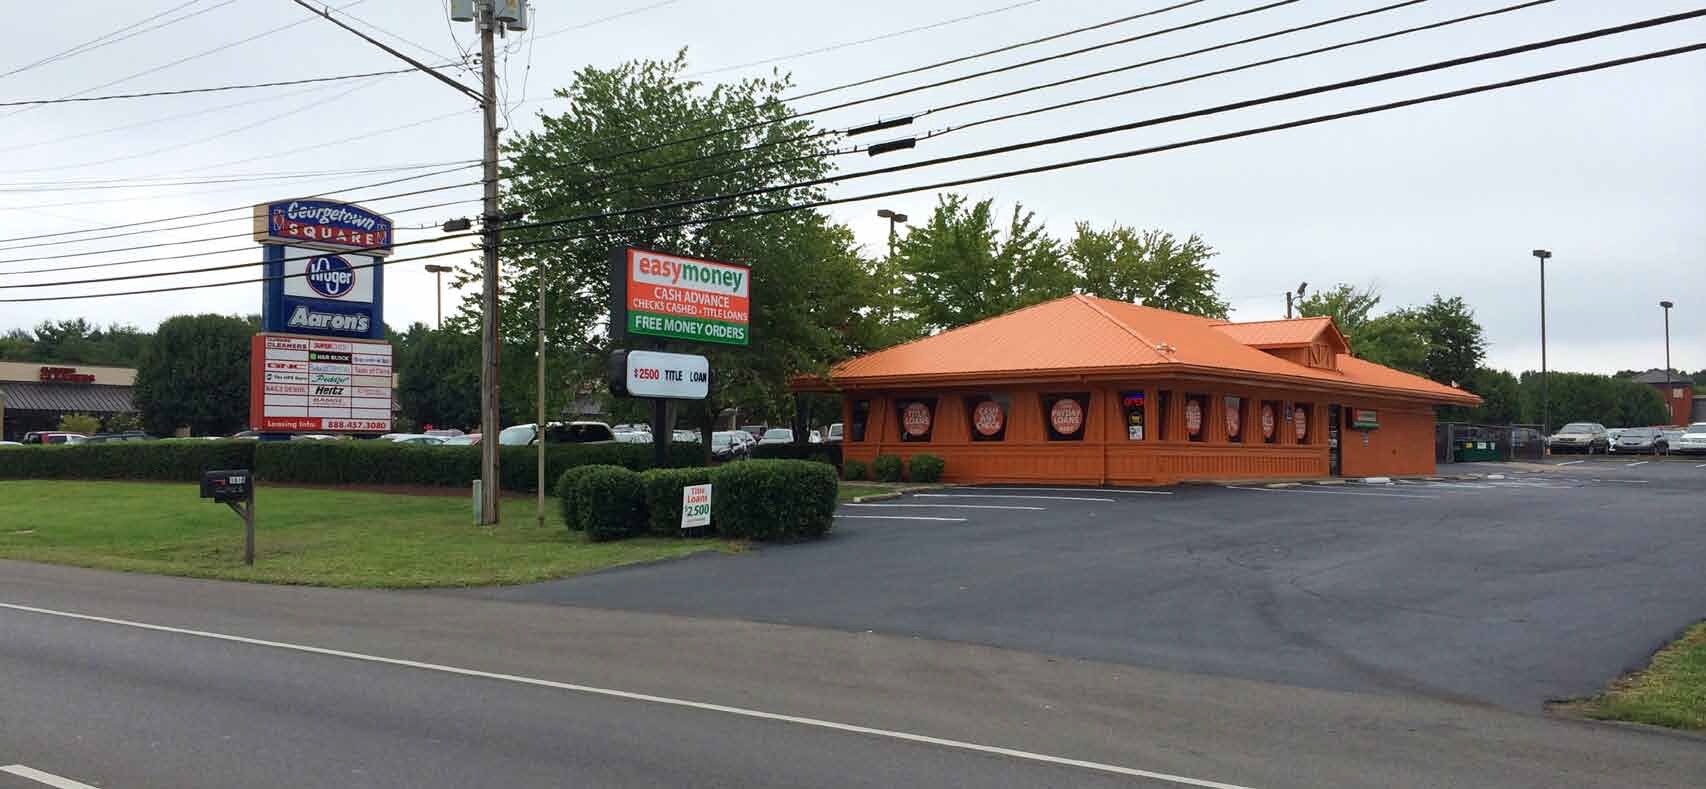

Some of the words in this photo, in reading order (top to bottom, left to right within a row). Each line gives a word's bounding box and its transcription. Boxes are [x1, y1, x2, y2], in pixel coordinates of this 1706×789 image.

[288, 202, 375, 230] Georgetown
[288, 223, 375, 245] SQUARE
[311, 257, 352, 294] Kroger
[654, 287, 682, 302] CASH
[683, 291, 729, 308] ADVANCE
[288, 305, 369, 332] Aaron's
[633, 298, 665, 312] CHECKS
[666, 302, 698, 315] CASHED
[703, 307, 722, 319] TITLE
[723, 310, 748, 321] LOANS
[635, 315, 662, 331] FREE
[664, 318, 704, 335] MONEY
[705, 325, 745, 339] ORDERS
[633, 367, 660, 380] $2500
[665, 369, 683, 381] TITLE
[689, 371, 707, 383] LOAN
[315, 386, 344, 395] Hertz
[267, 418, 298, 429] Leasing
[1054, 416, 1080, 425] LOANS
